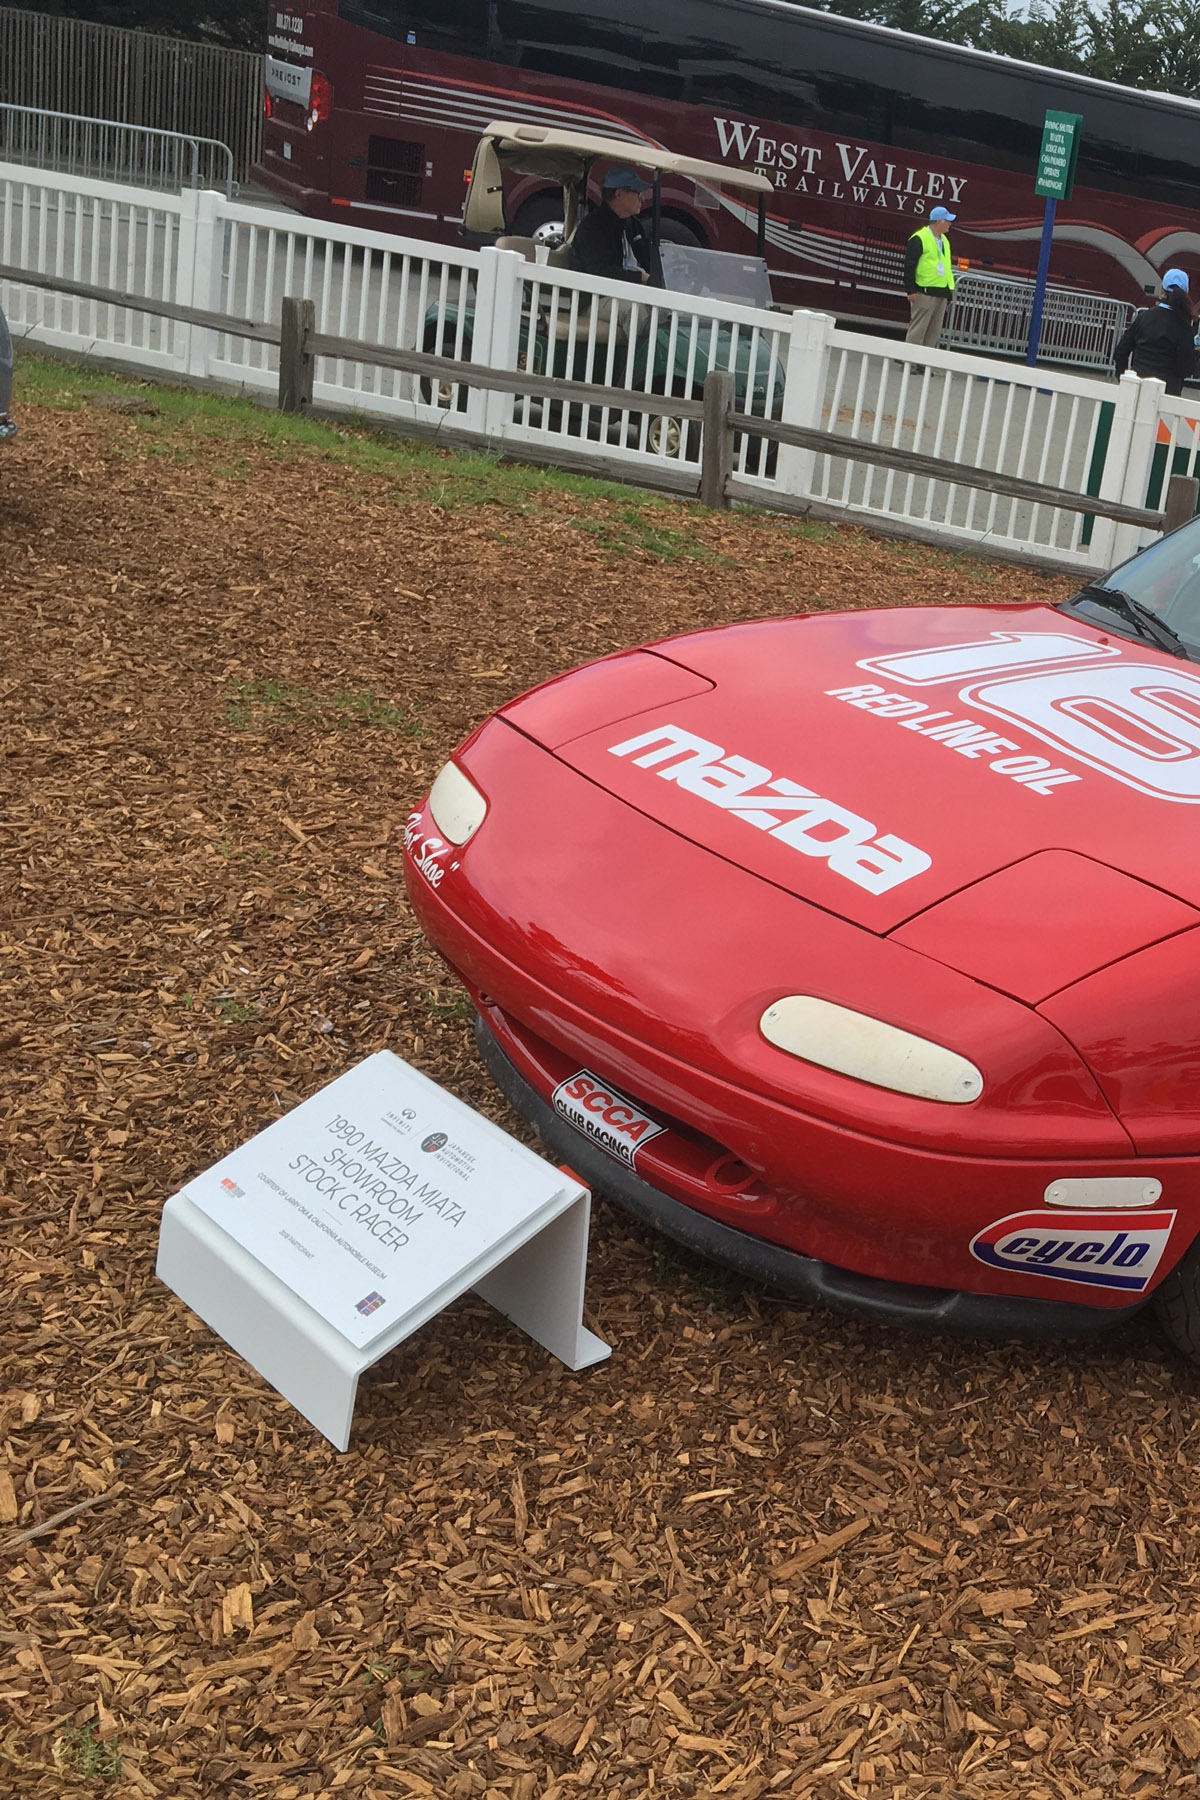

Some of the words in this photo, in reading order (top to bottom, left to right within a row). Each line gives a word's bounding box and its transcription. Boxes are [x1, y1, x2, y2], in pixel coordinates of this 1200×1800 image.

[713, 116, 822, 174] WEST
[835, 142, 968, 203] VALLEY
[823, 683, 930, 719] RED
[898, 708, 1021, 759] LINE
[989, 755, 1083, 795] OIL
[556, 1098, 585, 1130] CLUB
[585, 1120, 630, 1161] RACING
[565, 1078, 651, 1142] SCCA
[288, 1154, 347, 1200] STOCK
[338, 1194, 359, 1210] C
[350, 1203, 410, 1253] RACER
[323, 1148, 424, 1227] SHOWROOM
[324, 1114, 365, 1147] 1990
[357, 1140, 419, 1191] MAZDA
[412, 1182, 467, 1228] MIATA
[257, 1172, 281, 1192] COURTESY
[278, 1190, 288, 1198] OF
[284, 1195, 301, 1209] LARRY
[311, 1216, 339, 1241] CALIFORNIA
[335, 1237, 367, 1264] AUTOMOBILE
[364, 1260, 388, 1280] MUSEUM
[1000, 1232, 1151, 1268] cyclo
